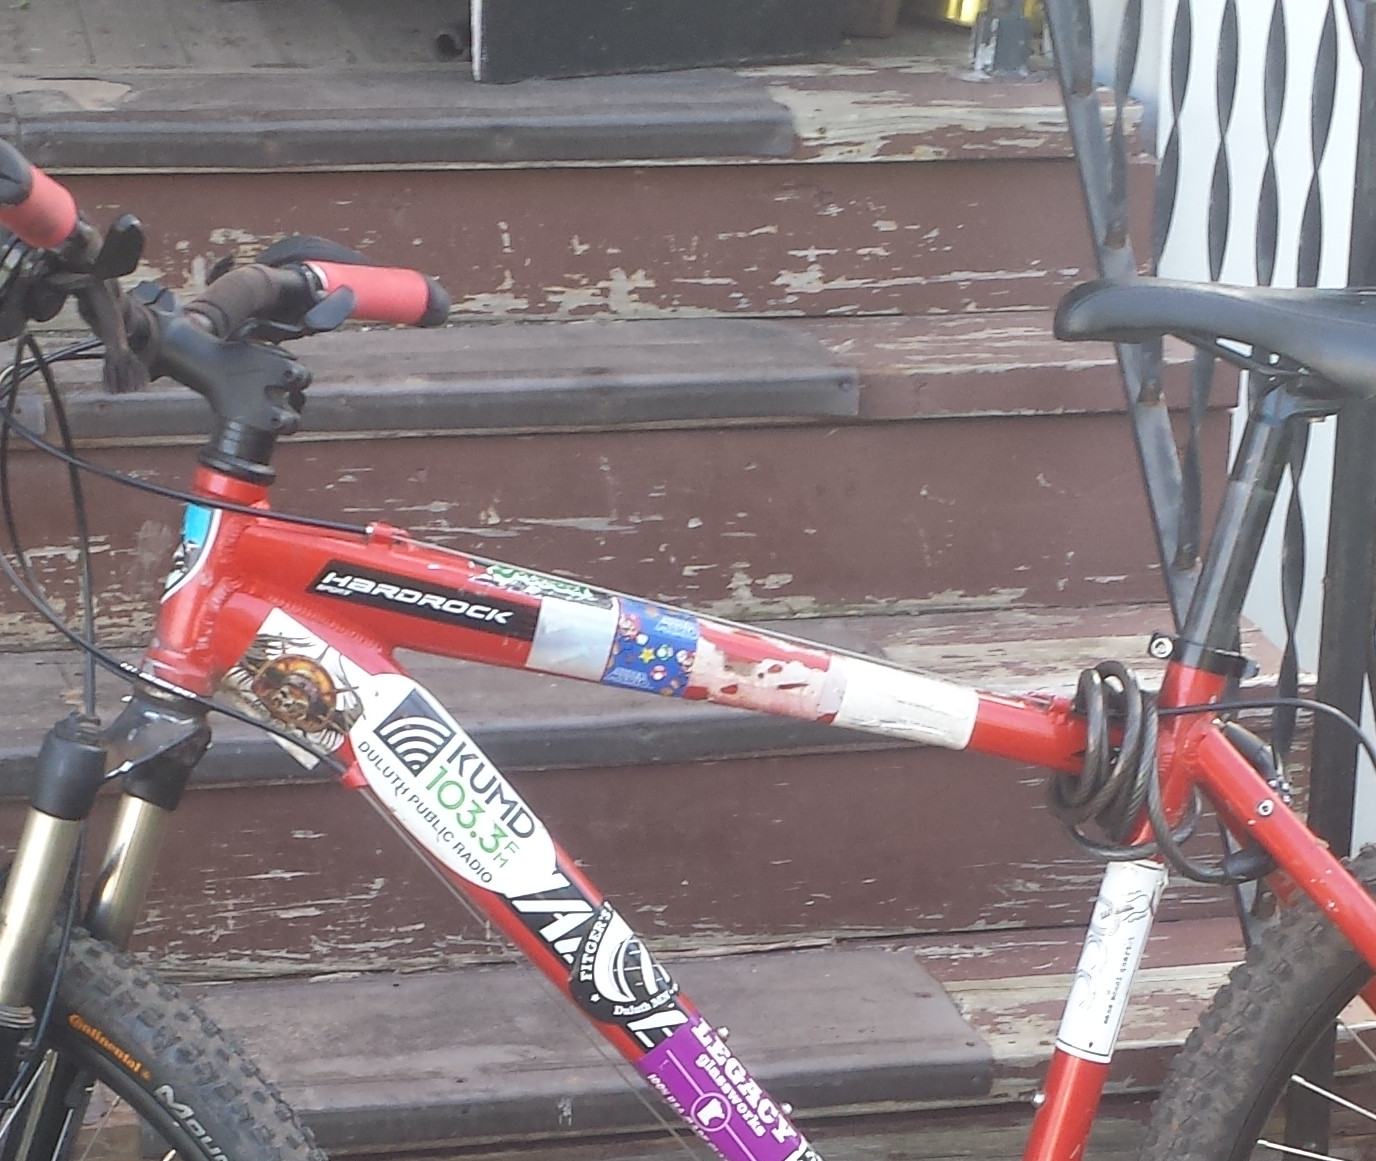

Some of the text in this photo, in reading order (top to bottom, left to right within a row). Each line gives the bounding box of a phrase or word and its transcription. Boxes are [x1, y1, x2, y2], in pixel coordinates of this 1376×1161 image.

[321, 571, 514, 624] HARDROCK
[357, 741, 494, 884] DULUTH PUBLIC RADIO
[425, 765, 509, 855] 103.3
[447, 741, 535, 838] KUMD
[580, 907, 614, 982] FITGER'S
[691, 1017, 798, 1144] LEGACY
[695, 1054, 766, 1137] glassworks
